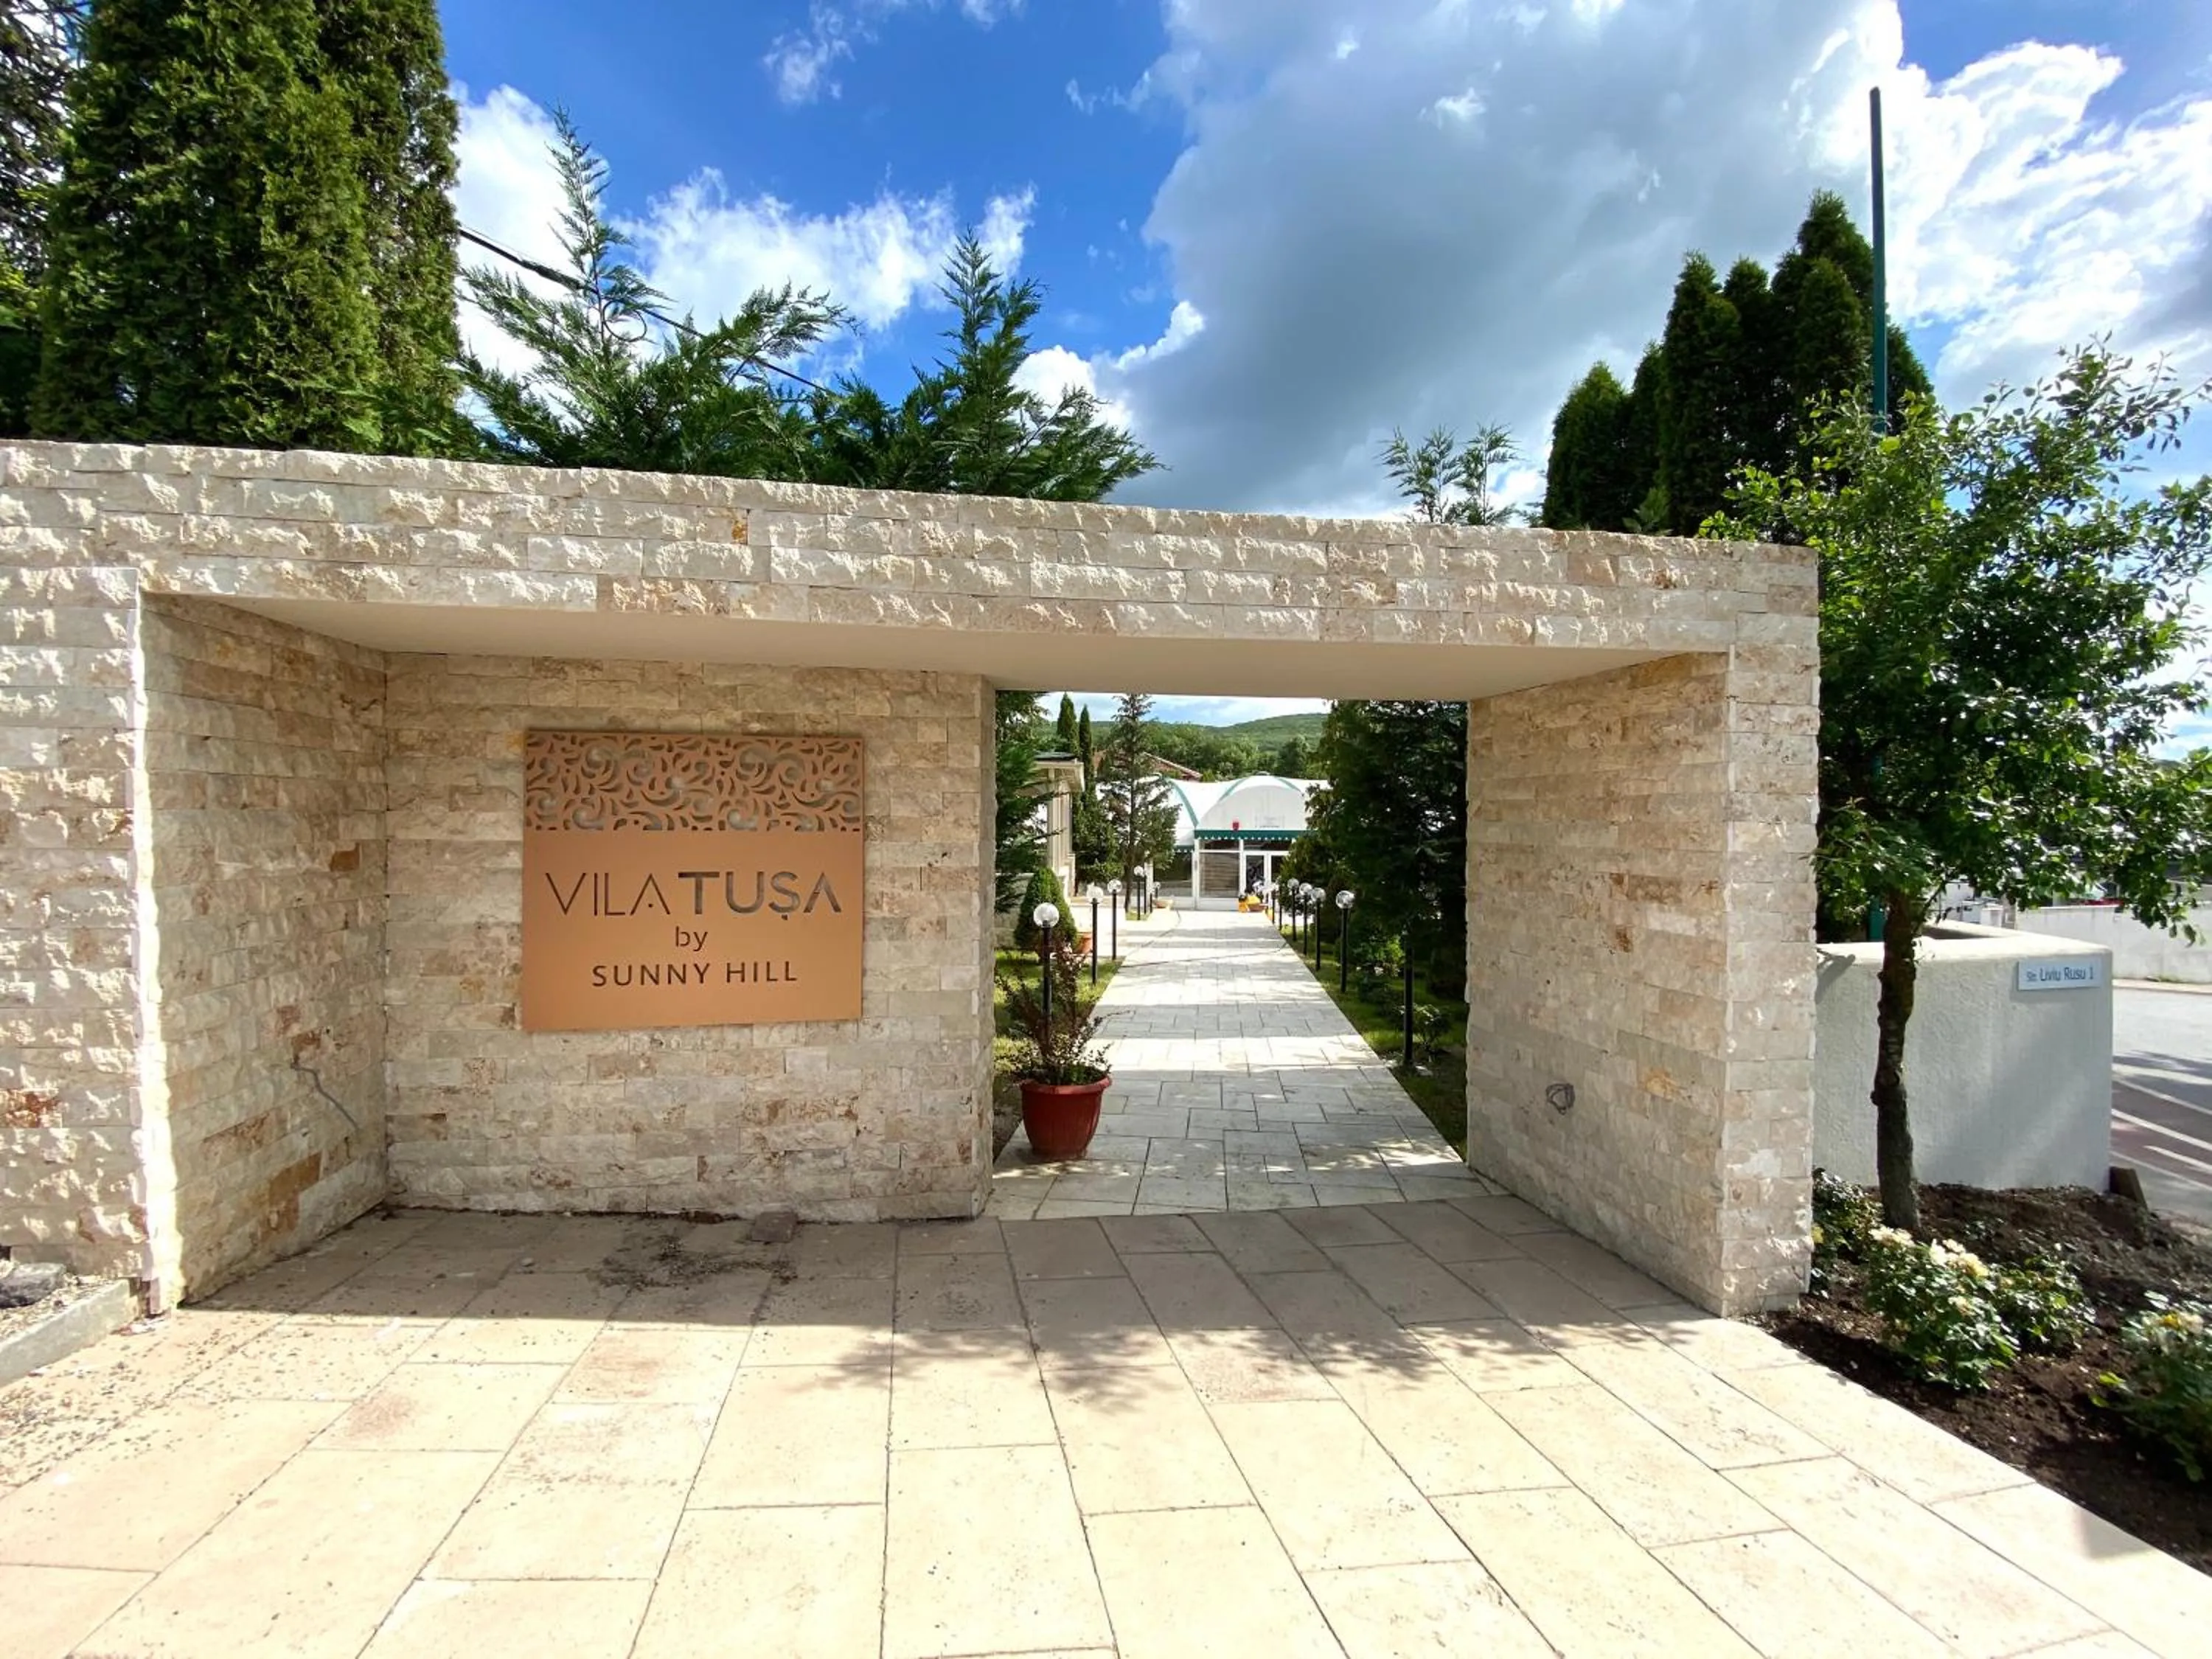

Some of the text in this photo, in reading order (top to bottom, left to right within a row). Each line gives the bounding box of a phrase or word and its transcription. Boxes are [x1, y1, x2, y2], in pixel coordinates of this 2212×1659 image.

[675, 926, 709, 951] by
[591, 961, 799, 987] SUNNY HILL
[2064, 967, 2087, 981] Rusu
